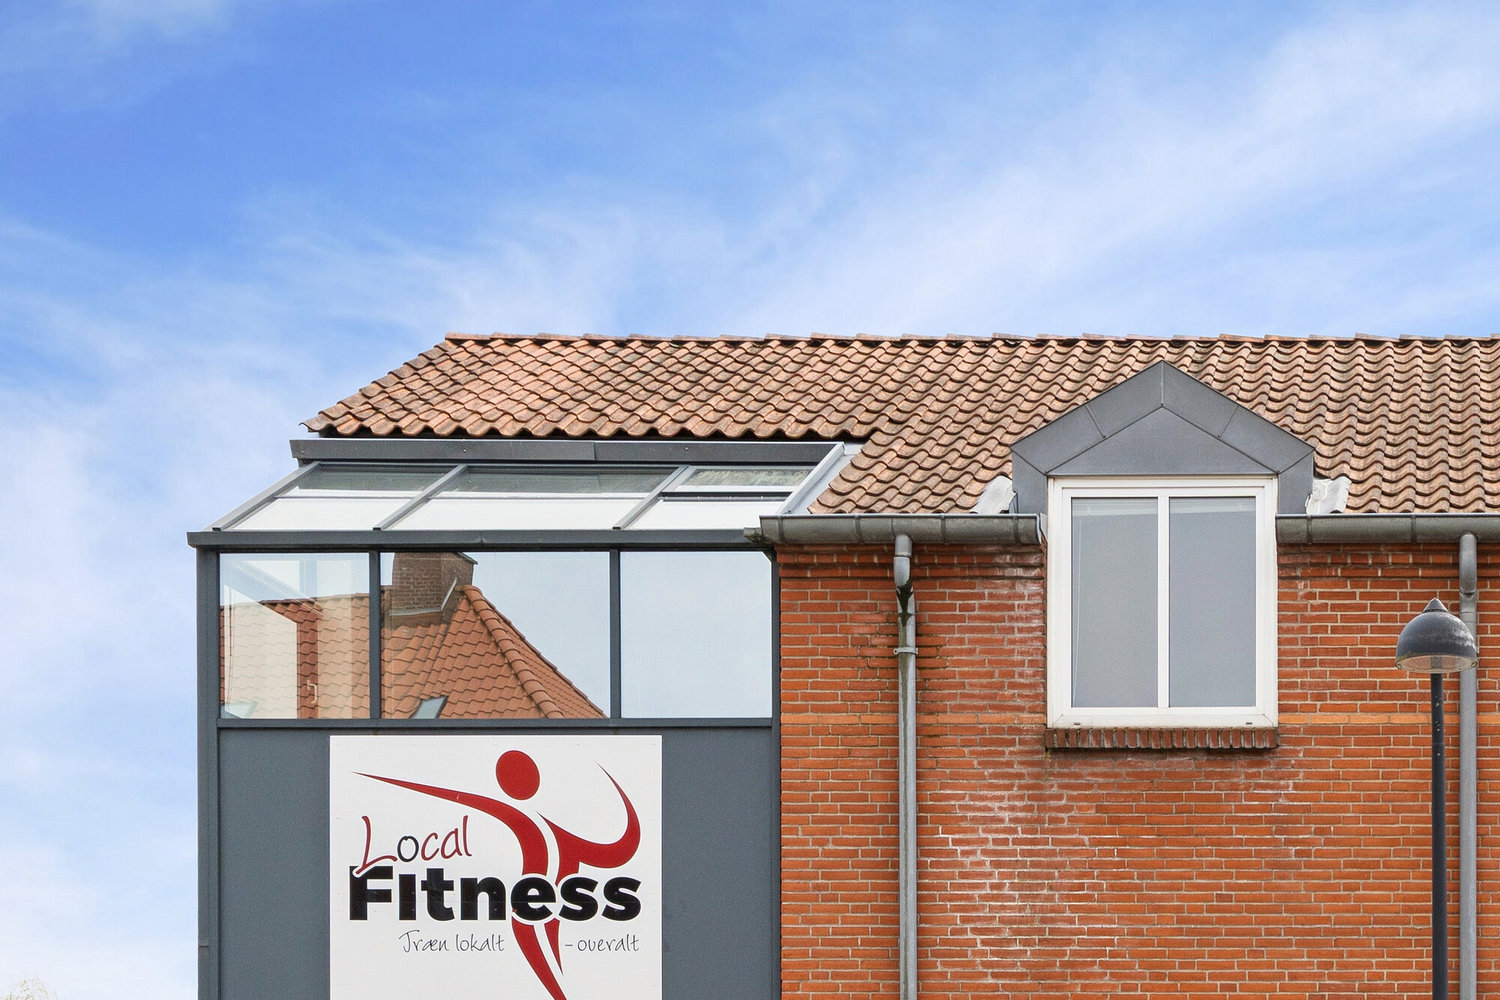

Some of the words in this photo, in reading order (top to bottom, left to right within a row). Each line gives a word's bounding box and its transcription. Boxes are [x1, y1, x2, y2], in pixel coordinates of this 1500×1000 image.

[352, 815, 472, 876] Local
[349, 866, 642, 922] Fitness
[398, 929, 449, 953] Træn
[455, 933, 505, 952] lokalt
[577, 933, 640, 952] overalt
